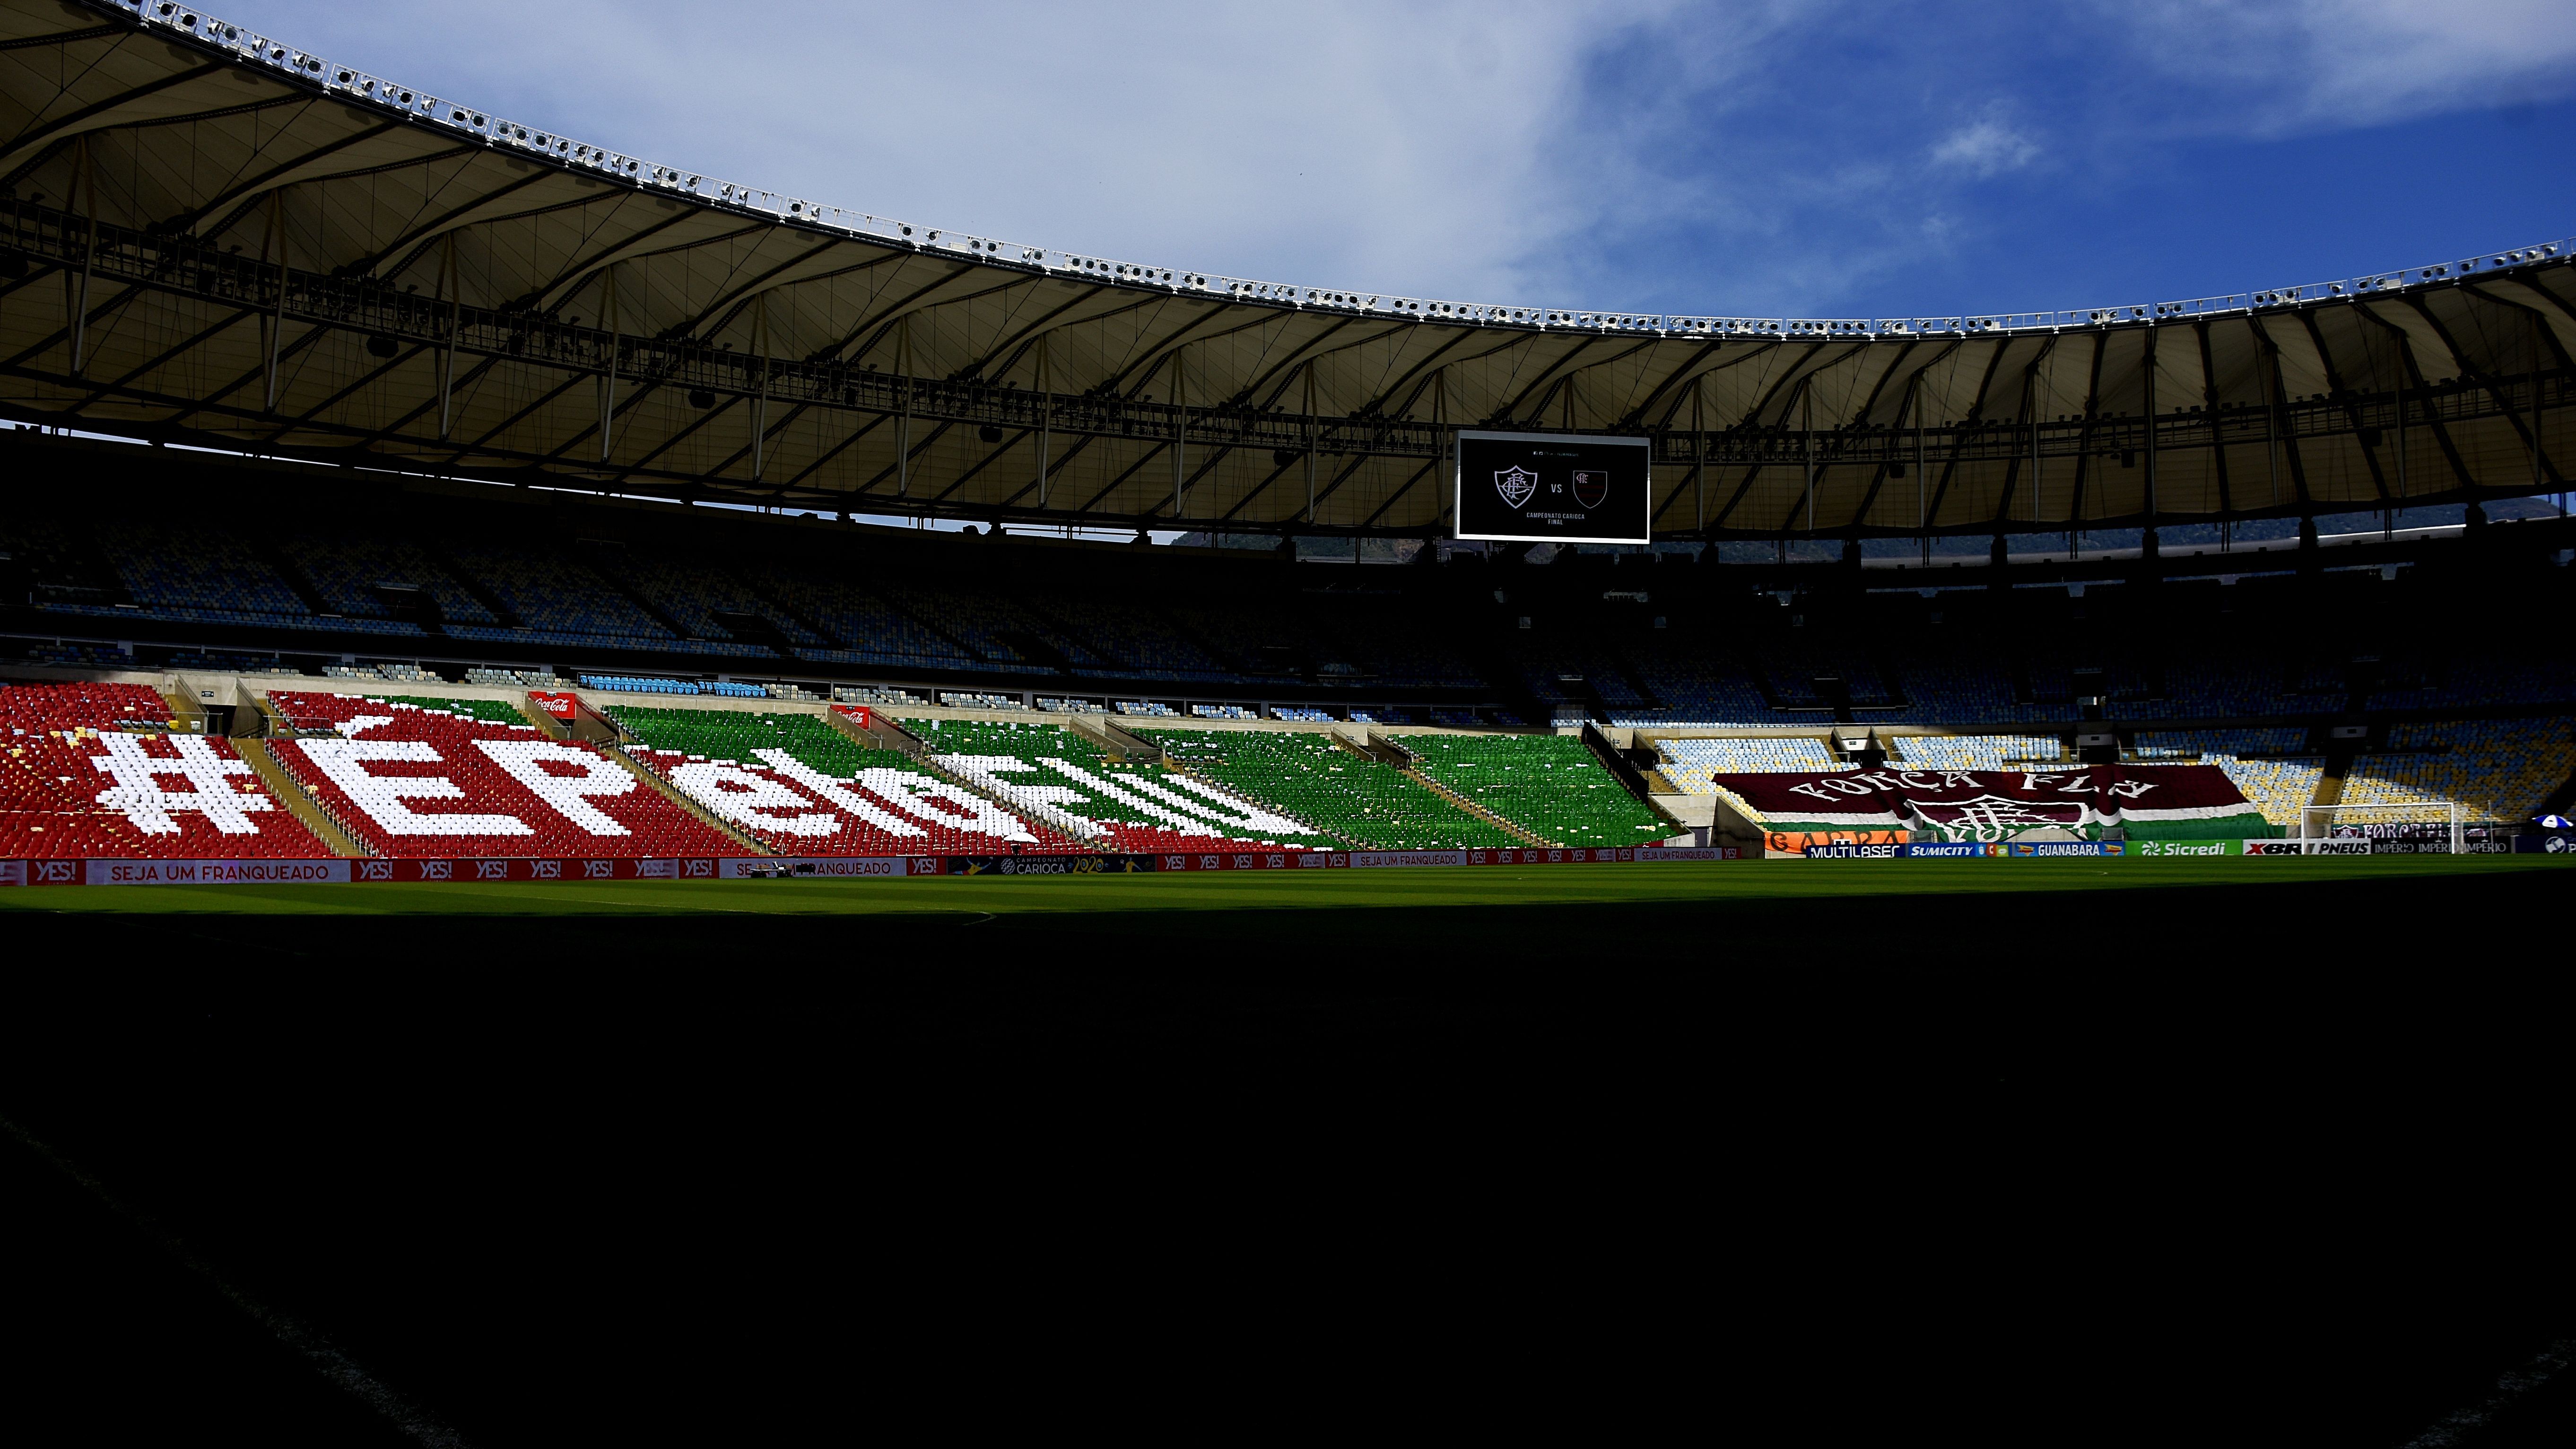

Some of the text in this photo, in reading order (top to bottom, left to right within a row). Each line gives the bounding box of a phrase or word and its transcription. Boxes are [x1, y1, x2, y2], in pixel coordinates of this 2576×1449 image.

[1551, 484, 1562, 493] VS
[1618, 849, 1631, 860] YES!
[1724, 848, 1737, 859] YES!
[1810, 845, 1900, 858] MULTILASER
[1911, 846, 1973, 856] SUMICITY
[2038, 844, 2100, 856] GUANABARA
[2164, 843, 2226, 855] Sicredi
[2318, 842, 2368, 854] PNEUS
[1200, 855, 1219, 869] YES!
[1233, 855, 1253, 869] YES!
[1266, 854, 1284, 868] YES!
[1328, 854, 1346, 866] YES!
[1361, 855, 1457, 866] SEJA UM FRANQUEADO
[1470, 851, 1486, 864] YES!
[1497, 851, 1512, 863] YES!
[1522, 851, 1537, 863] YES!
[1547, 850, 1562, 862] YES!
[1571, 850, 1585, 862] YES!
[1642, 851, 1714, 860] SEJA UM FRANQUEADO
[530, 860, 561, 878] YES!
[583, 860, 613, 877] YES!
[684, 860, 713, 876] YES!
[912, 858, 937, 873] YES!
[1017, 856, 1104, 874] CARIOCA 2020
[1165, 855, 1185, 870] YES!
[35, 862, 76, 881] YES!
[111, 865, 329, 881] SEJA UM FRANQUEADO
[359, 861, 393, 879] YES!
[419, 861, 452, 879] YES!
[475, 861, 507, 879] YES!
